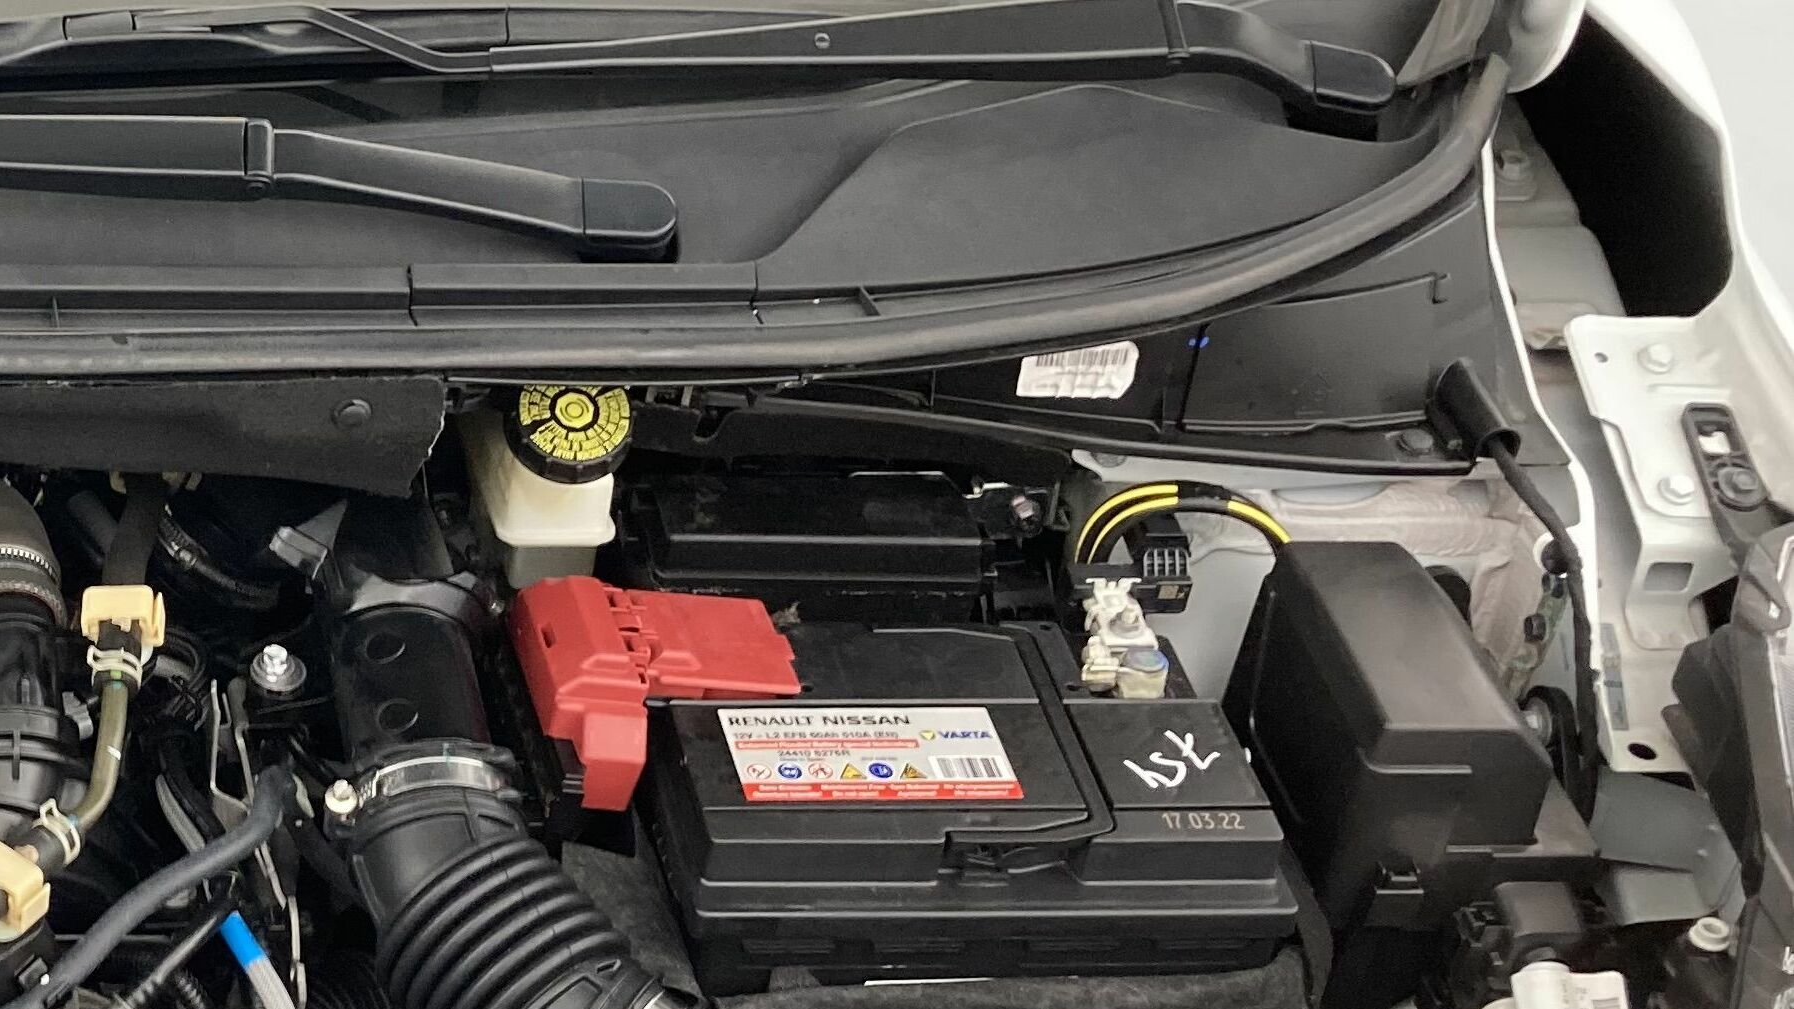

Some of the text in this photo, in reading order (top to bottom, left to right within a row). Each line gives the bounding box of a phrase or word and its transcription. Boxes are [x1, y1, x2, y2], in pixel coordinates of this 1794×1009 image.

[728, 715, 911, 727] RENAULT NISSAN
[938, 729, 994, 741] VARTA
